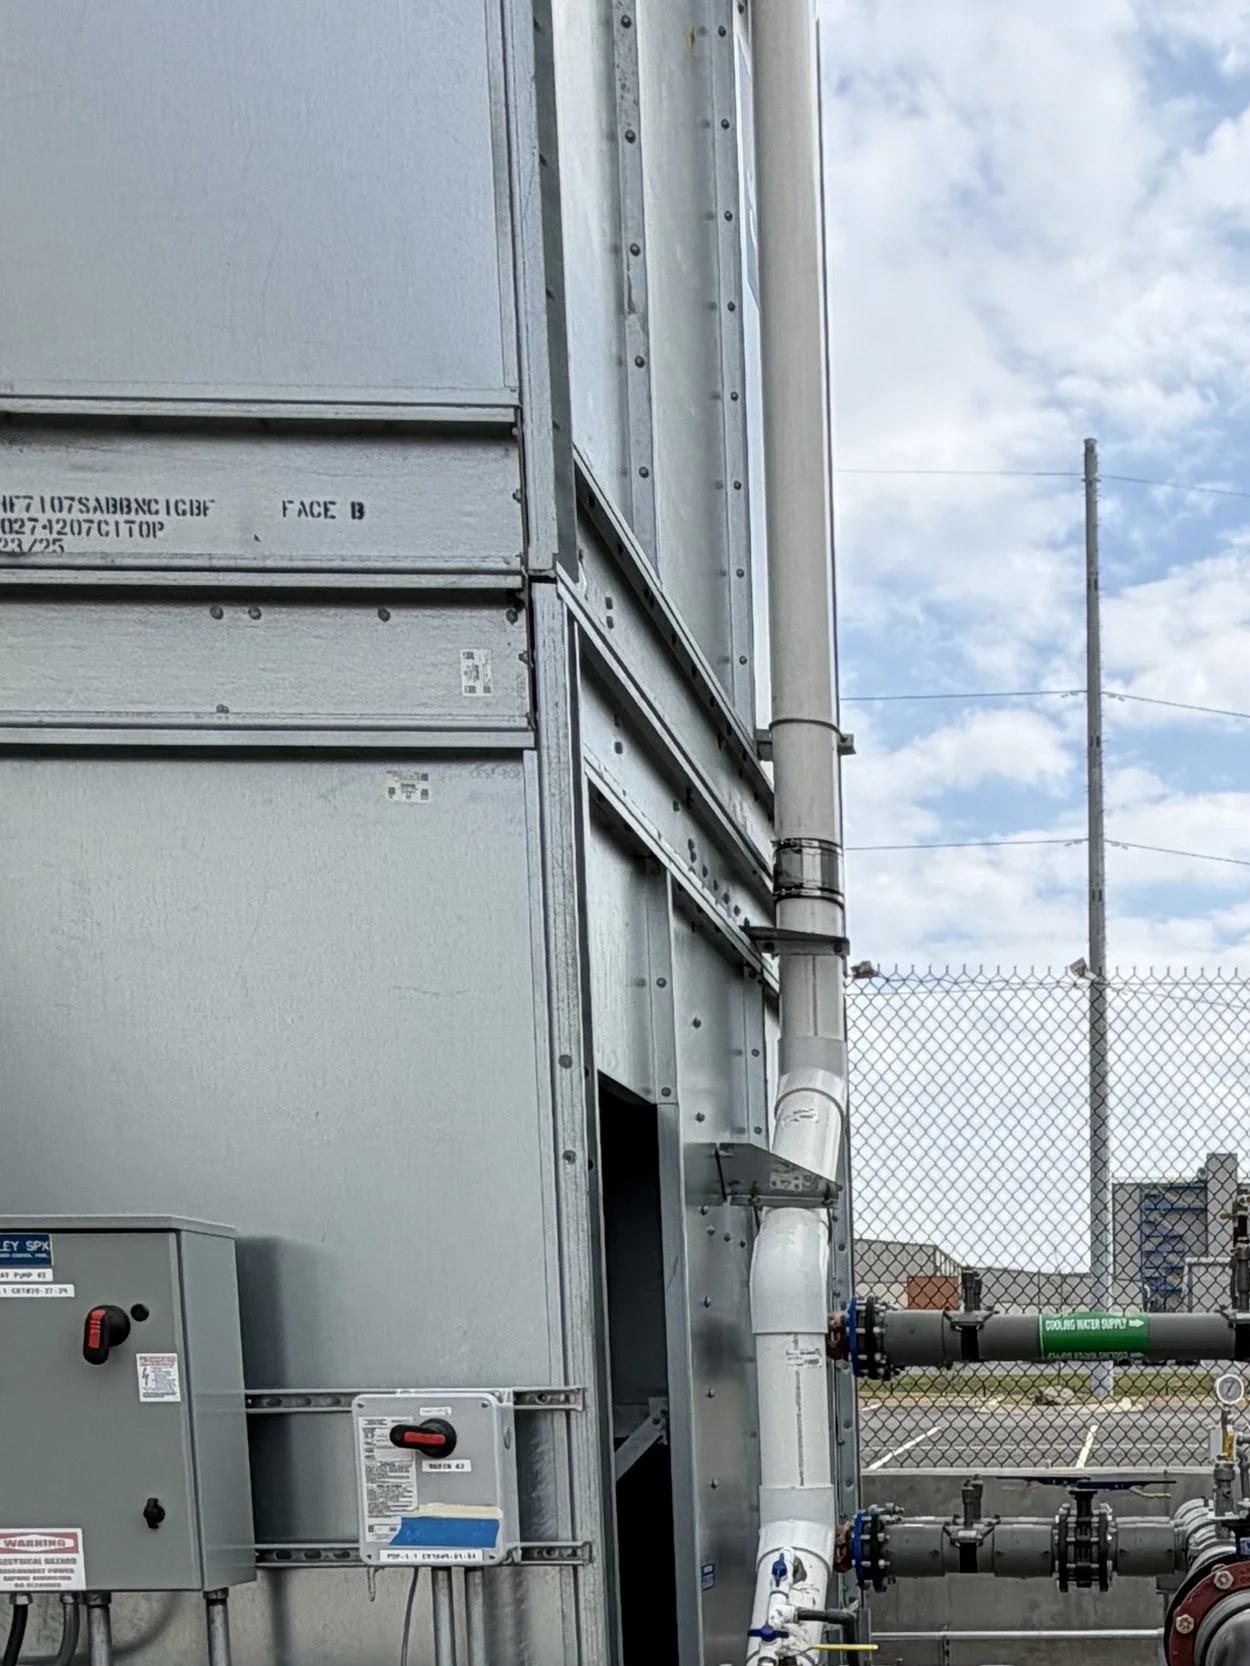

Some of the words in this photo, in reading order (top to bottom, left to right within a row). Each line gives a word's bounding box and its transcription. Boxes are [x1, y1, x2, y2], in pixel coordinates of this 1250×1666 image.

[282, 500, 337, 519] FACE
[351, 502, 365, 520] B
[26, 1240, 49, 1251] SPX
[1045, 1319, 1076, 1331] COOLING
[1076, 1318, 1100, 1330] WATER
[1101, 1318, 1127, 1329] SUPPLY
[4, 1539, 66, 1547] WARNING
